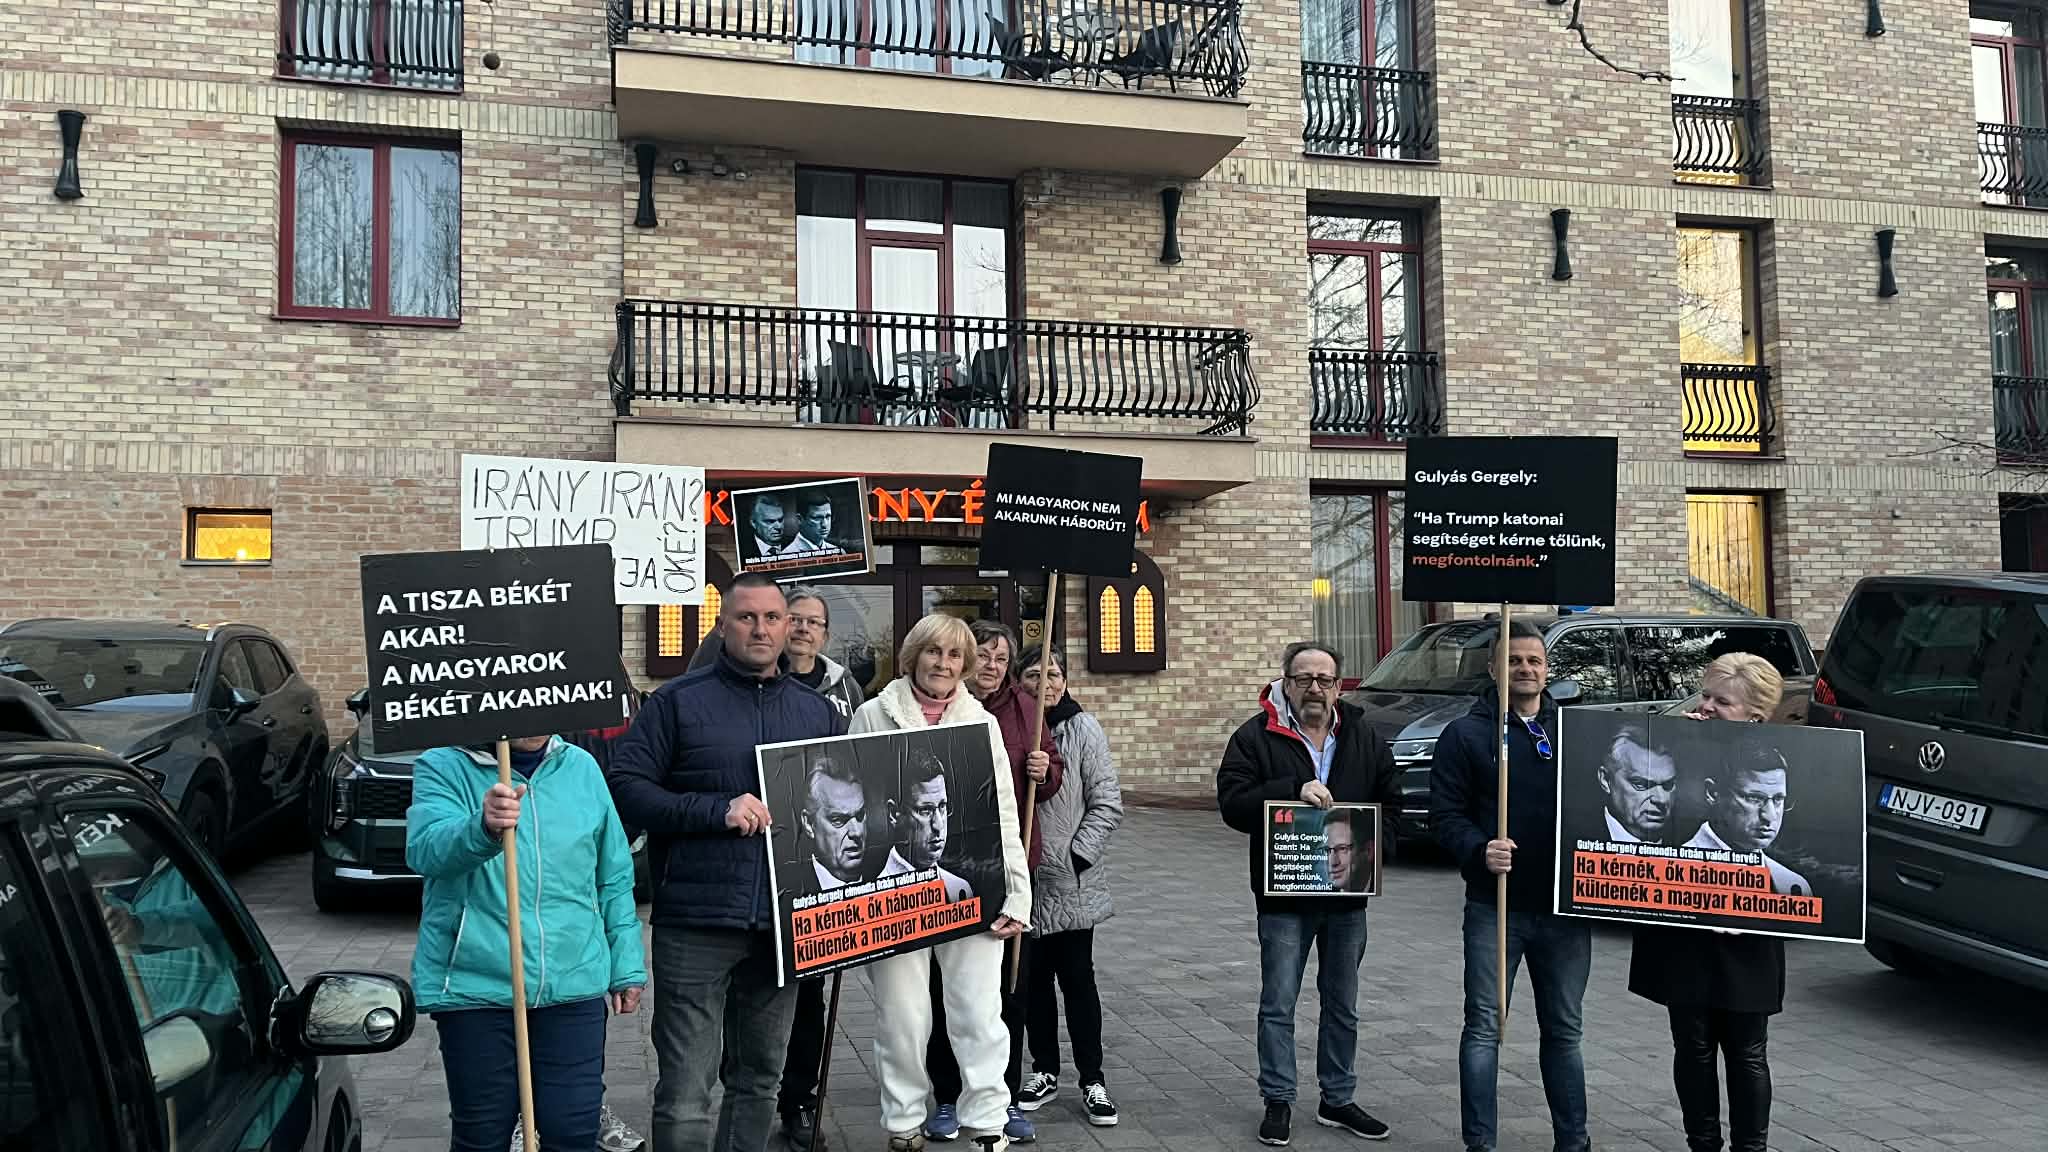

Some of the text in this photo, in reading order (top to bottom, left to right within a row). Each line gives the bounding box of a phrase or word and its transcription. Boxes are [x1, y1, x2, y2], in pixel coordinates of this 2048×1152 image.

[1414, 470, 1538, 486] Gulyás Gergely:
[473, 465, 590, 512] IRÁNY
[599, 470, 704, 522] IRÁN?
[996, 492, 1121, 514] MI MAGYAROK NEM
[994, 510, 1057, 525] AKARUNK
[1060, 514, 1126, 532] HÁBORÚT!
[1446, 512, 1499, 528] Trump
[1503, 512, 1564, 526] katonai
[1412, 533, 1606, 550] segítséget kérne tőlünk,
[376, 577, 572, 614] A TISZA BÉKÉT
[379, 625, 466, 650] AKAR!
[381, 651, 567, 686] A MAGYAROK
[384, 681, 614, 722] BÉKÉT AKARNAK!
[1892, 789, 1979, 826] NJV-091
[1273, 833, 1329, 843] Gulyás Gergely
[1274, 853, 1300, 862] Trump
[1577, 840, 1760, 864] Gulyás Gergely elmondta Orbán valódi tervét:
[1274, 863, 1313, 873] segítséget
[1297, 873, 1323, 882] tőlünk,
[1576, 856, 1765, 889] Ha kérnék, ők háborúba
[817, 889, 844, 903] Gergely
[1274, 883, 1333, 892] megfontolnánk!
[1575, 879, 1819, 918] küldenék a magyar katonákat.
[794, 887, 942, 936] Ha kérnék, ők háborúba
[796, 932, 858, 964] küldenék
[861, 930, 869, 946] a
[872, 917, 917, 943] magyar
[919, 902, 980, 928] katonákat.
